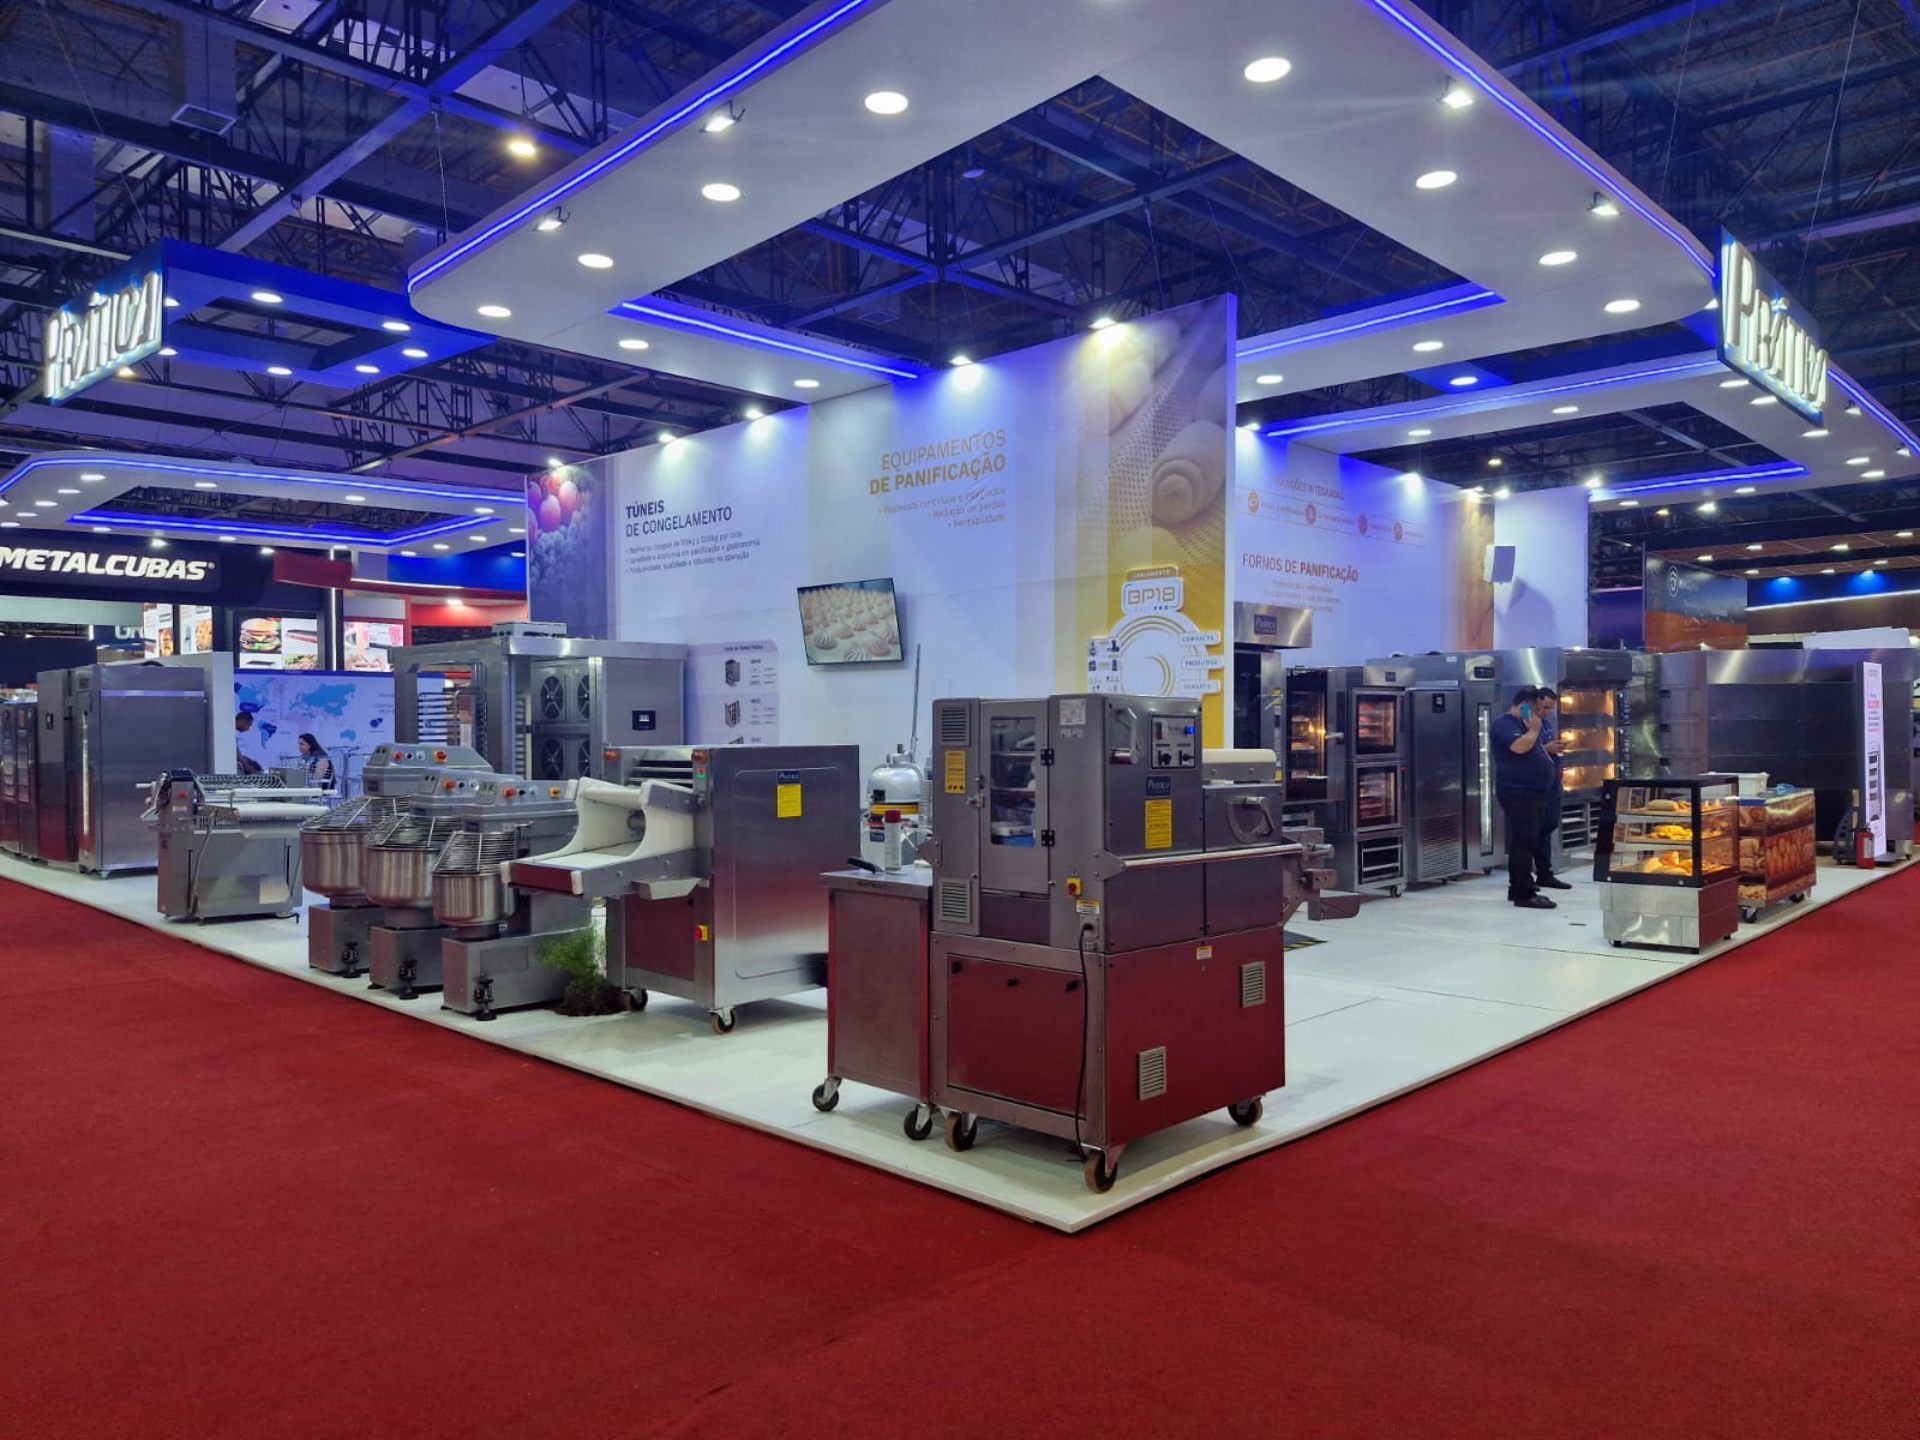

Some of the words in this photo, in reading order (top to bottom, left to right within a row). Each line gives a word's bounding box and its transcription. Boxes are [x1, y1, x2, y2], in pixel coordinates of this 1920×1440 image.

[882, 429, 1007, 472] EQUIPAMENTOS
[870, 476, 890, 495] DE
[895, 451, 1007, 490] PANIFICAÇÃO
[626, 500, 665, 519] TÚNEIS
[626, 522, 640, 537] DE
[642, 507, 732, 535] CONGELAMENTO
[1242, 553, 1282, 572] FORNOS
[1284, 559, 1297, 574] DE
[1300, 562, 1359, 584] PANIFICAÇÃO
[1127, 586, 1176, 605] BP18
